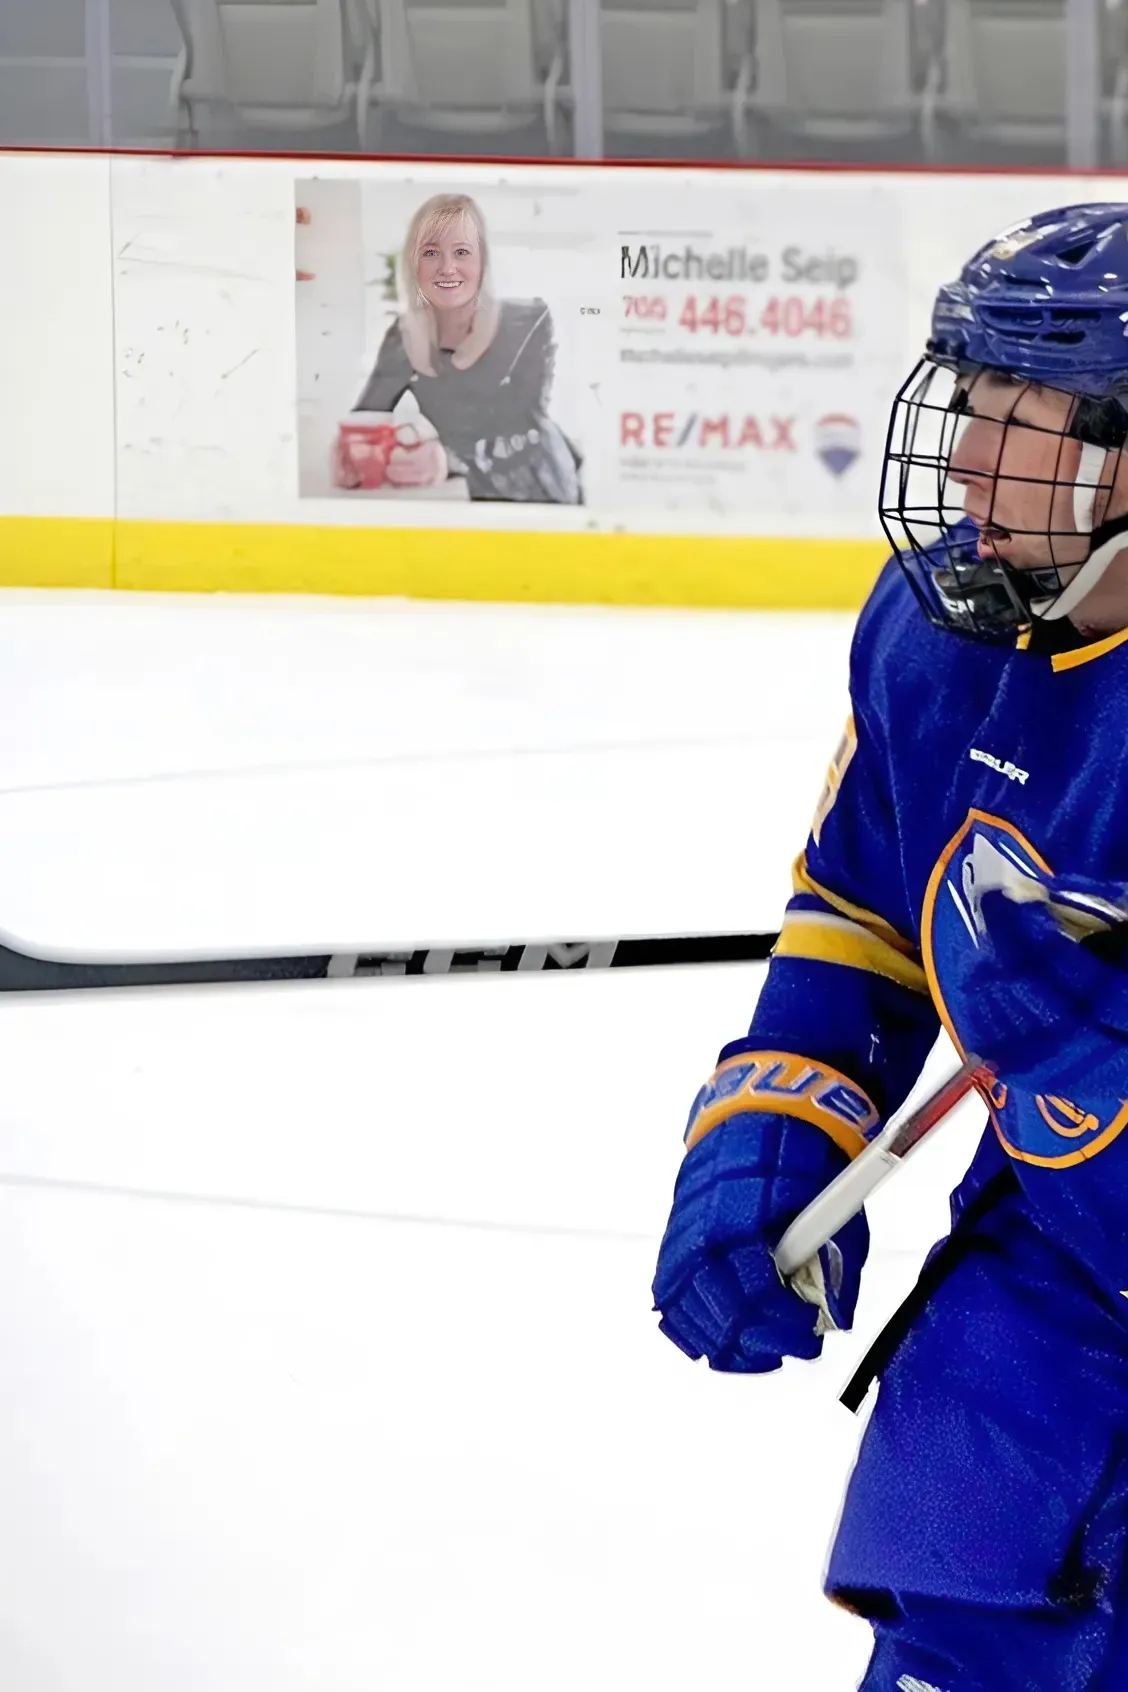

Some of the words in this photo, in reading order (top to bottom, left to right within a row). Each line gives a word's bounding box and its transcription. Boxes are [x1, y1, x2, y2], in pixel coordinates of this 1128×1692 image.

[619, 245, 771, 283] Michelle
[780, 245, 859, 290] Seip
[678, 295, 855, 340] 446.4046
[619, 411, 797, 451] RE/MAX
